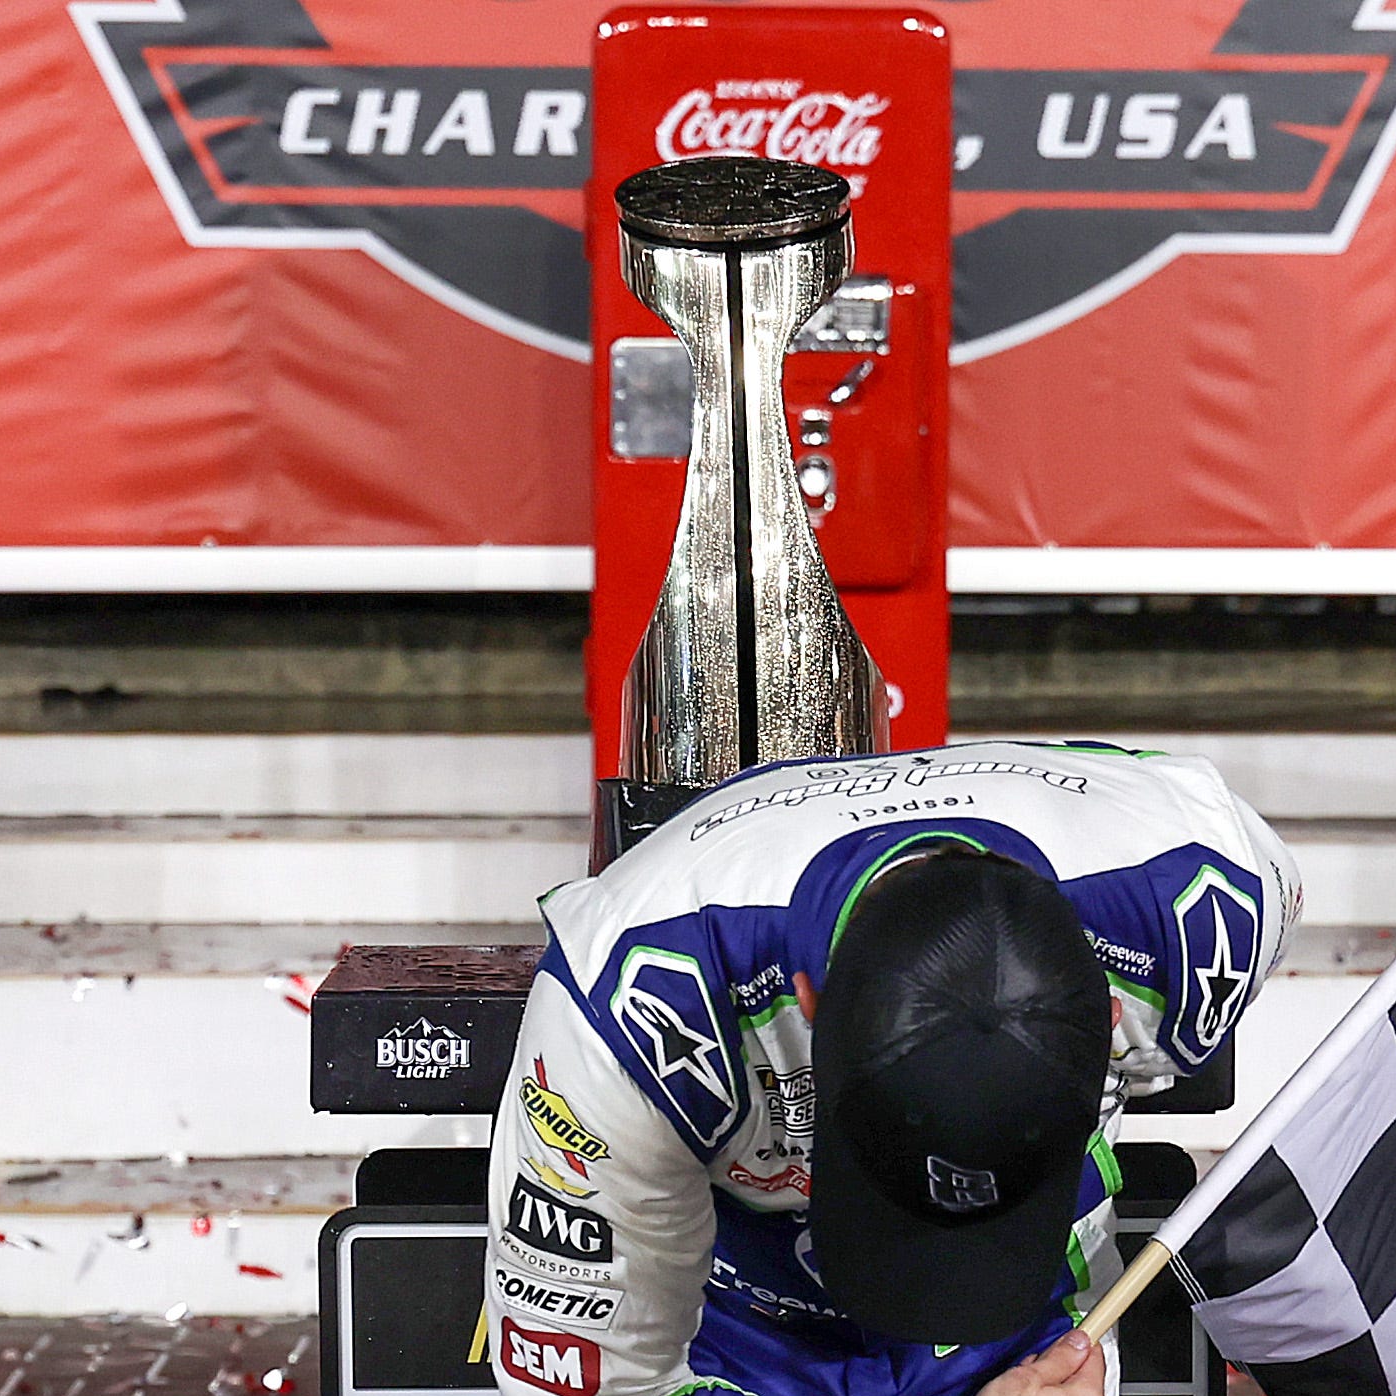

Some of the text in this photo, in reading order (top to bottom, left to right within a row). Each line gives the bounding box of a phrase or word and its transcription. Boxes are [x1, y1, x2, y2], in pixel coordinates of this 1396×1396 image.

[655, 88, 892, 166] Coca-Cola
[1037, 92, 1258, 160] USA
[837, 794, 976, 823] respect.
[1093, 936, 1156, 970] Freeway
[376, 1038, 471, 1067] BUSCH
[396, 1065, 450, 1078] LIGHT
[522, 1083, 603, 1156] SUNOCO
[516, 1188, 603, 1253] TWG
[499, 1235, 613, 1282] MOTORSPORTS
[496, 1269, 614, 1320] COMETIC
[508, 1330, 584, 1390] SEM
